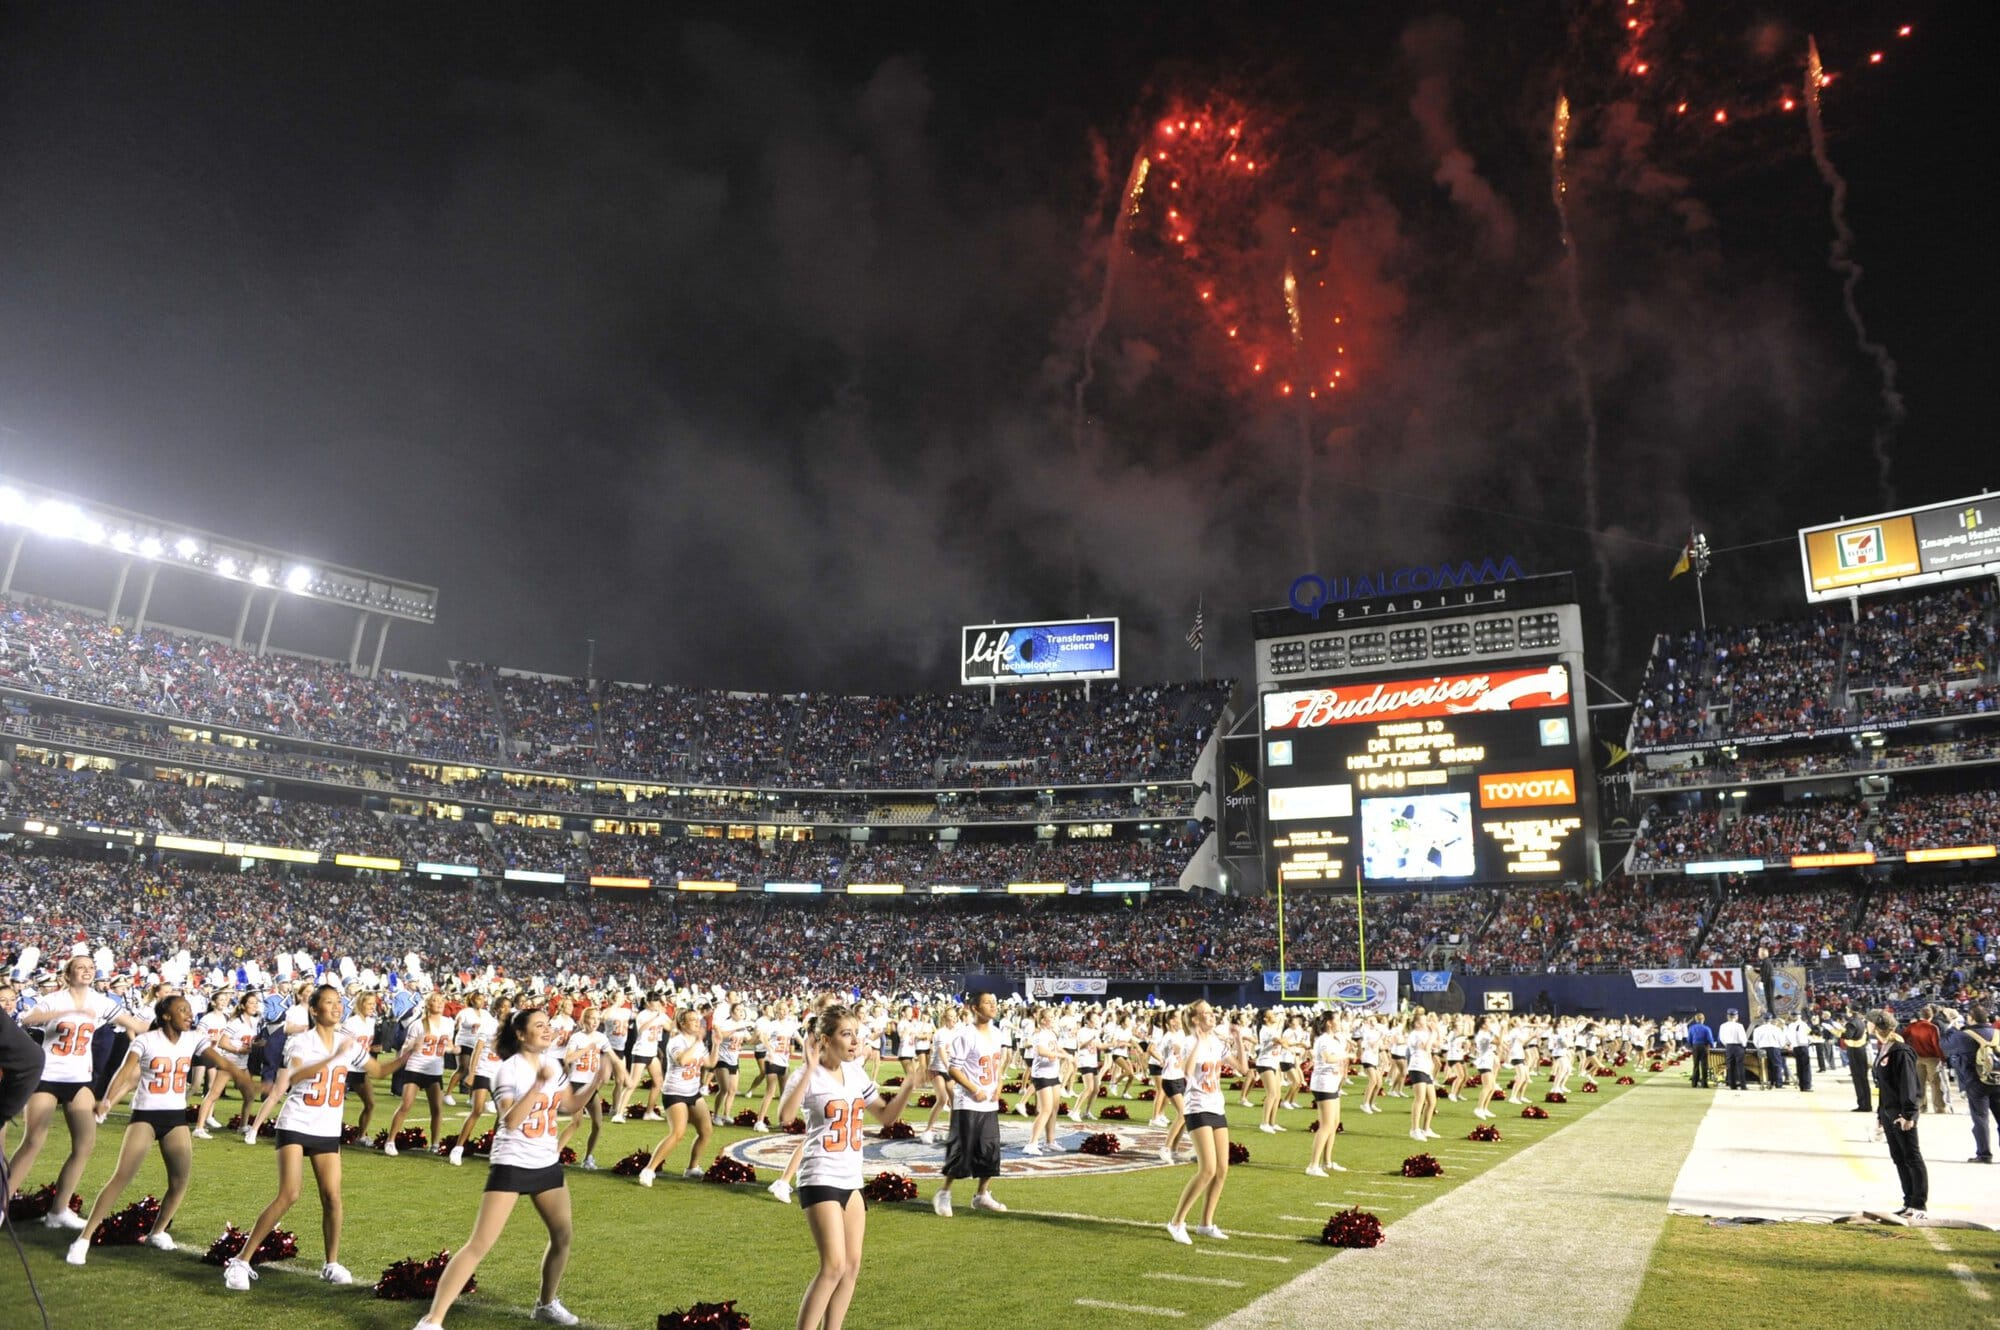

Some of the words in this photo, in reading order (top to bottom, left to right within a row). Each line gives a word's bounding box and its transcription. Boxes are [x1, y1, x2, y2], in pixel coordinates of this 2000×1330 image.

[1920, 534, 1967, 549] Imaging
[1288, 555, 1524, 620] QUALCOMM
[1337, 589, 1506, 618] STADIUM
[1046, 632, 1109, 645] Transforming
[1060, 642, 1095, 651] science
[966, 631, 1016, 674] life
[1001, 660, 1058, 672] technologies
[1291, 675, 1490, 728] Budweiser
[1426, 720, 1444, 733] TO
[1813, 727, 1843, 736] OCATION
[1367, 738, 1391, 753] DR
[1395, 733, 1455, 751] PEPPER
[1483, 779, 1571, 801] TOYOTA
[1226, 794, 1256, 808] Sprint
[1032, 979, 1048, 996] A
[1710, 970, 1734, 990] N
[1487, 992, 1510, 1009] 25
[51, 1021, 95, 1056] 36
[422, 1034, 449, 1057] 36
[148, 1056, 191, 1095] 36
[303, 1065, 348, 1107] 36
